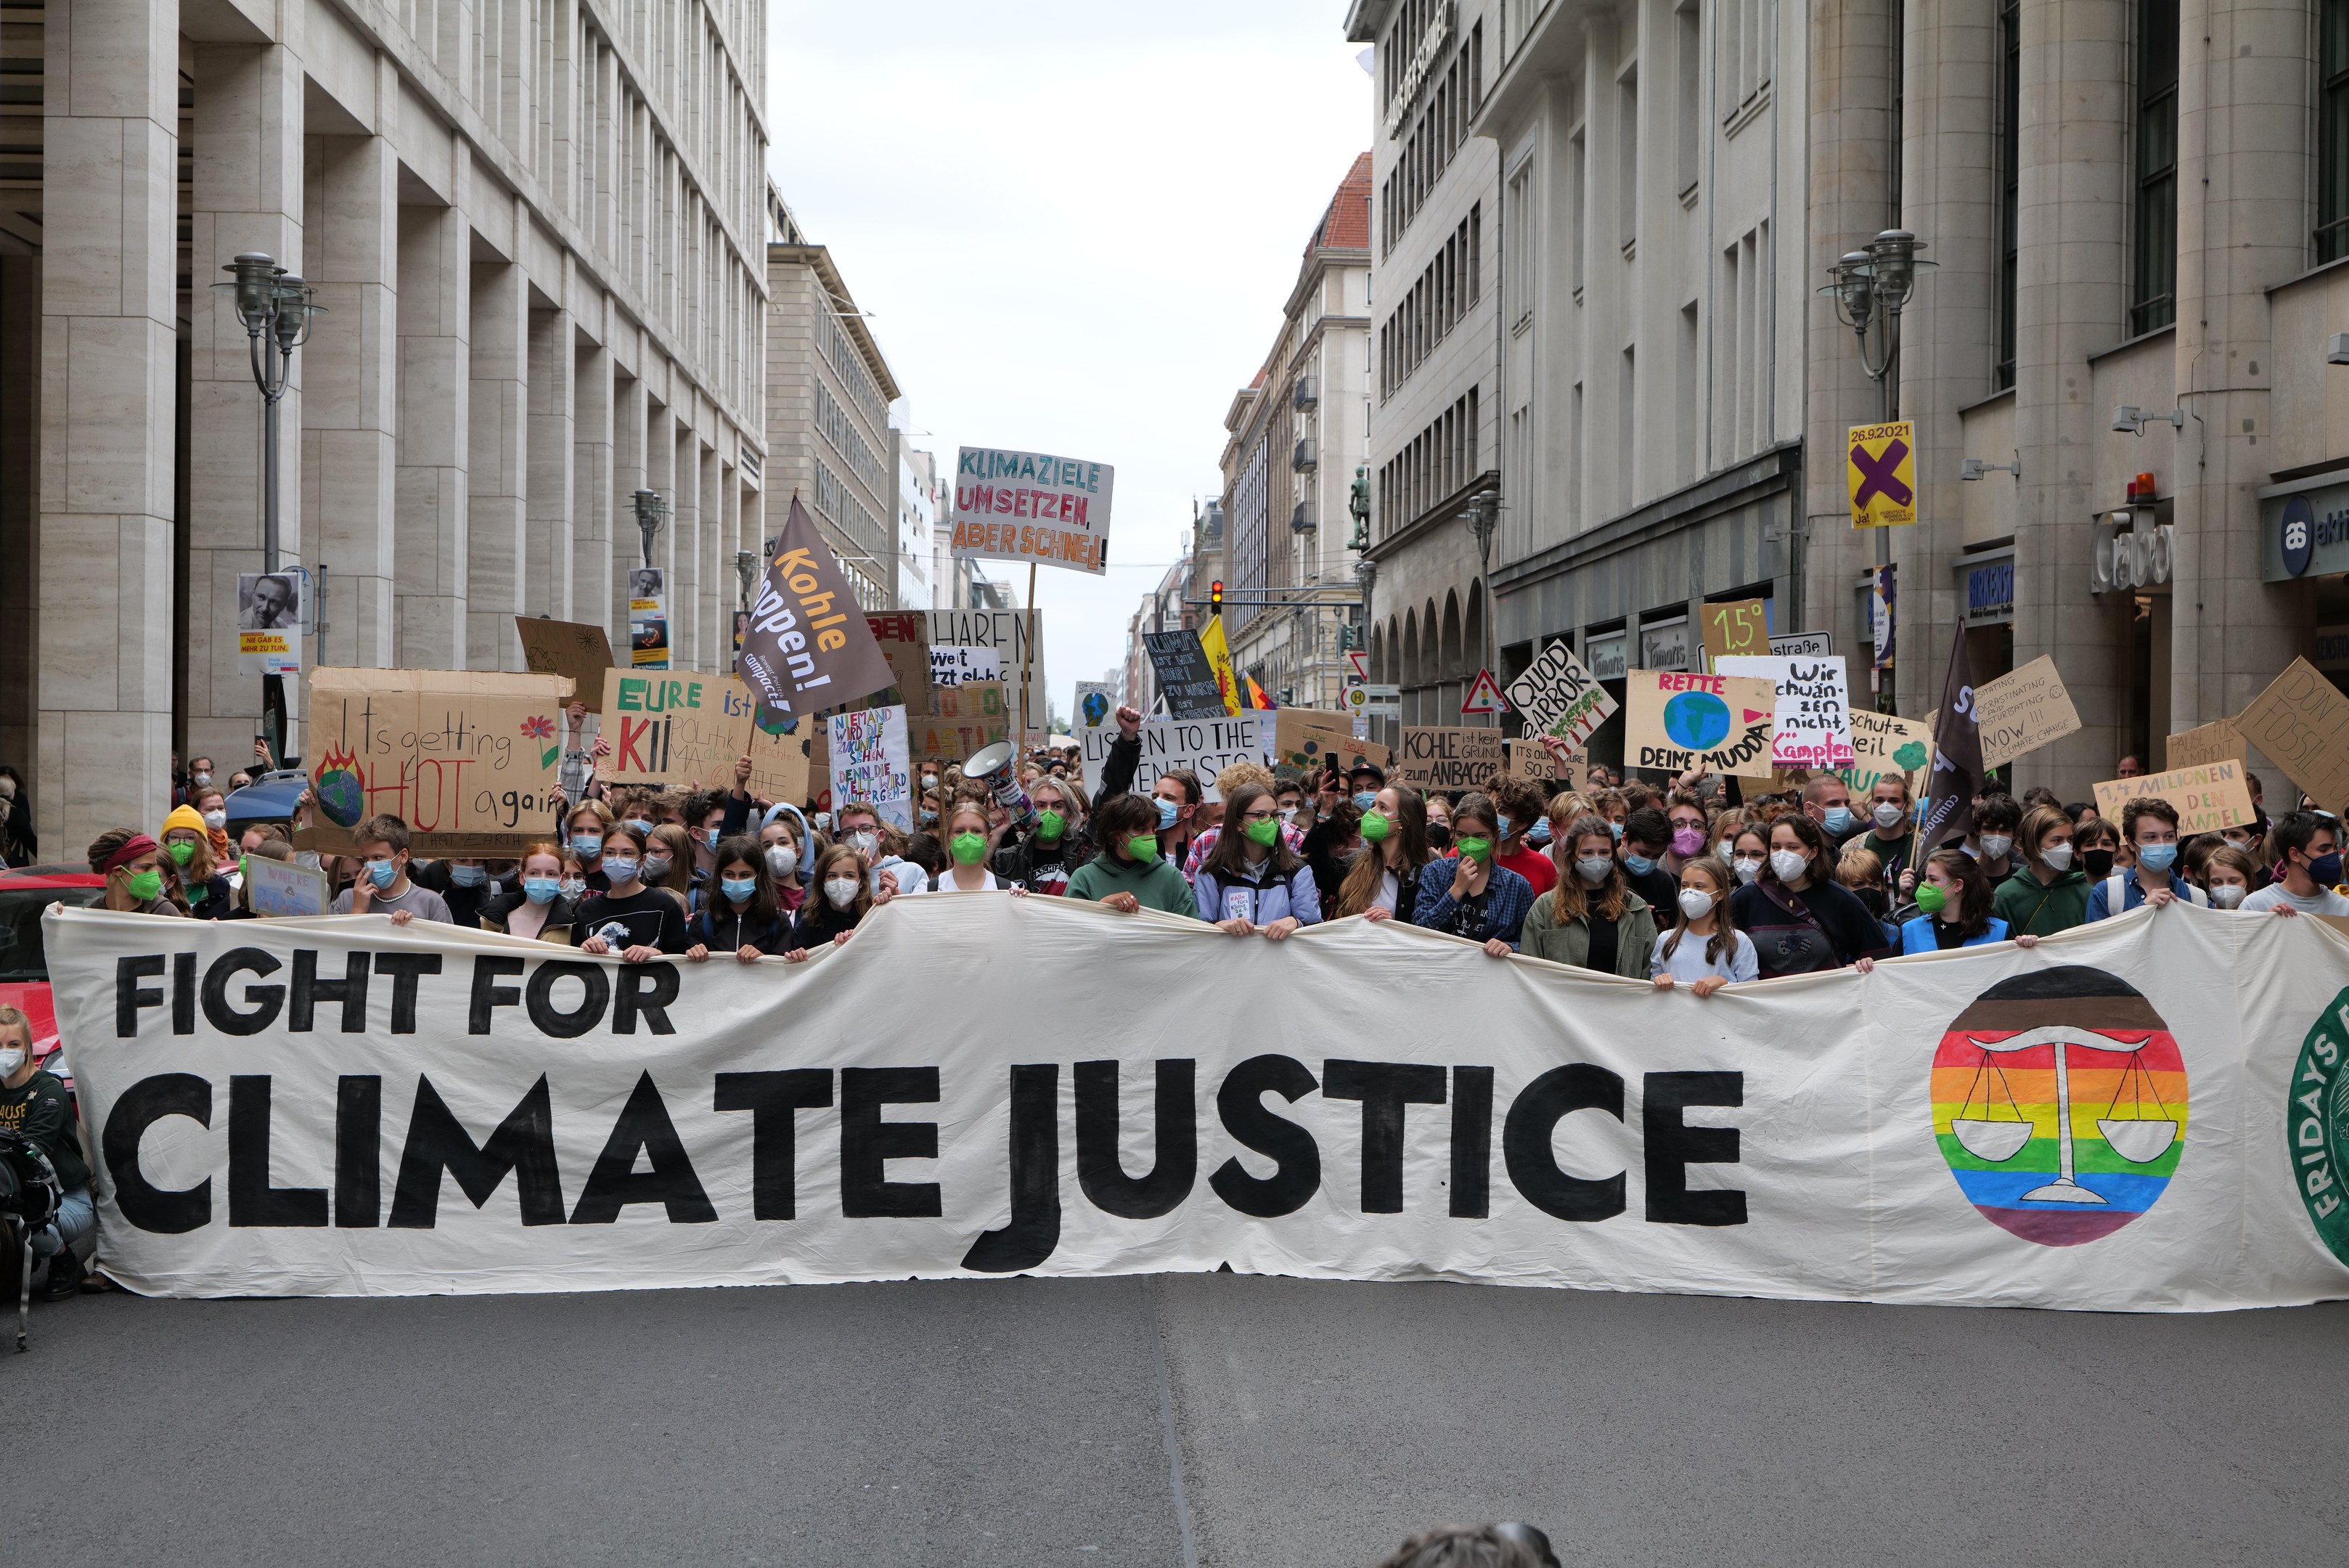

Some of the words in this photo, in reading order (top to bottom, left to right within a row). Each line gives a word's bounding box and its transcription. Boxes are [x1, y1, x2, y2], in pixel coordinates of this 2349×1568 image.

[1851, 425, 1909, 443] 26.9.2021
[960, 451, 1100, 493] KLIMAZIELE
[957, 484, 1090, 530] UMSETZEN,
[1855, 513, 1870, 524] Ja!
[952, 520, 1016, 552] ABER
[1020, 525, 1107, 570] SCHNELL!
[774, 547, 848, 653] Kohle
[750, 567, 831, 692] oppen!
[1145, 632, 1199, 653] KLIMA
[1153, 656, 1172, 666] IST
[1175, 653, 1196, 665] WIE
[1790, 662, 1837, 682] Wir
[759, 655, 775, 675] Bewegt
[772, 675, 784, 699] Politik
[1166, 685, 1182, 696] ZU
[1185, 680, 1220, 696] WARM
[1511, 645, 1569, 708] QUOD
[1659, 674, 1726, 695] RETTE
[1776, 679, 1844, 698] chwän-
[1974, 676, 2016, 701] ESITATING
[617, 678, 703, 712] EURE
[724, 690, 751, 717] ist
[965, 689, 1000, 716] TO
[1177, 700, 1193, 709] IST
[1532, 665, 1591, 733] ARBOR
[1975, 677, 2046, 715] OCRASTINATING
[836, 708, 891, 730] NIEMAND
[1988, 705, 2004, 716] AND
[836, 725, 862, 741] WIRD
[867, 722, 883, 738] DIE
[1174, 725, 1203, 752] TO
[1210, 721, 1254, 749] THE
[1786, 714, 1845, 735] nicht,
[1983, 720, 2025, 753] NOW
[401, 711, 511, 781] getting
[836, 735, 881, 754] ZUKUNFT
[909, 726, 1005, 756] LASTIK
[1405, 732, 1460, 759] KOHLE
[1463, 732, 1475, 744] ist
[1478, 732, 1499, 746] kein
[2000, 735, 2034, 759] CLIMATE
[2037, 719, 2069, 741] CHANGE
[2170, 728, 2205, 754] PAUSE
[2214, 721, 2236, 739] FOR
[850, 748, 886, 765] SEHEN,
[1462, 745, 1501, 759] GRUND
[1640, 746, 1694, 770] DEINE
[2178, 755, 2186, 767] A
[839, 766, 870, 783] DENN
[874, 763, 891, 778] DIE
[1405, 769, 1429, 782] zum
[1525, 761, 1542, 777] SO
[1545, 765, 1574, 779] STP
[2137, 764, 2234, 796] MILIONEN
[365, 759, 475, 832] HOT
[836, 777, 874, 796] WELT
[879, 773, 907, 790] WIRD
[475, 788, 557, 828] again
[2187, 790, 2226, 810] DEN
[463, 833, 523, 847] EARTH
[117, 947, 442, 1038] FIGHT
[469, 954, 681, 1039] FOR
[2299, 1033, 2342, 1220] FRIDAYS
[102, 1067, 943, 1235] CLIMATE
[960, 1053, 1749, 1273] JUSTICE
